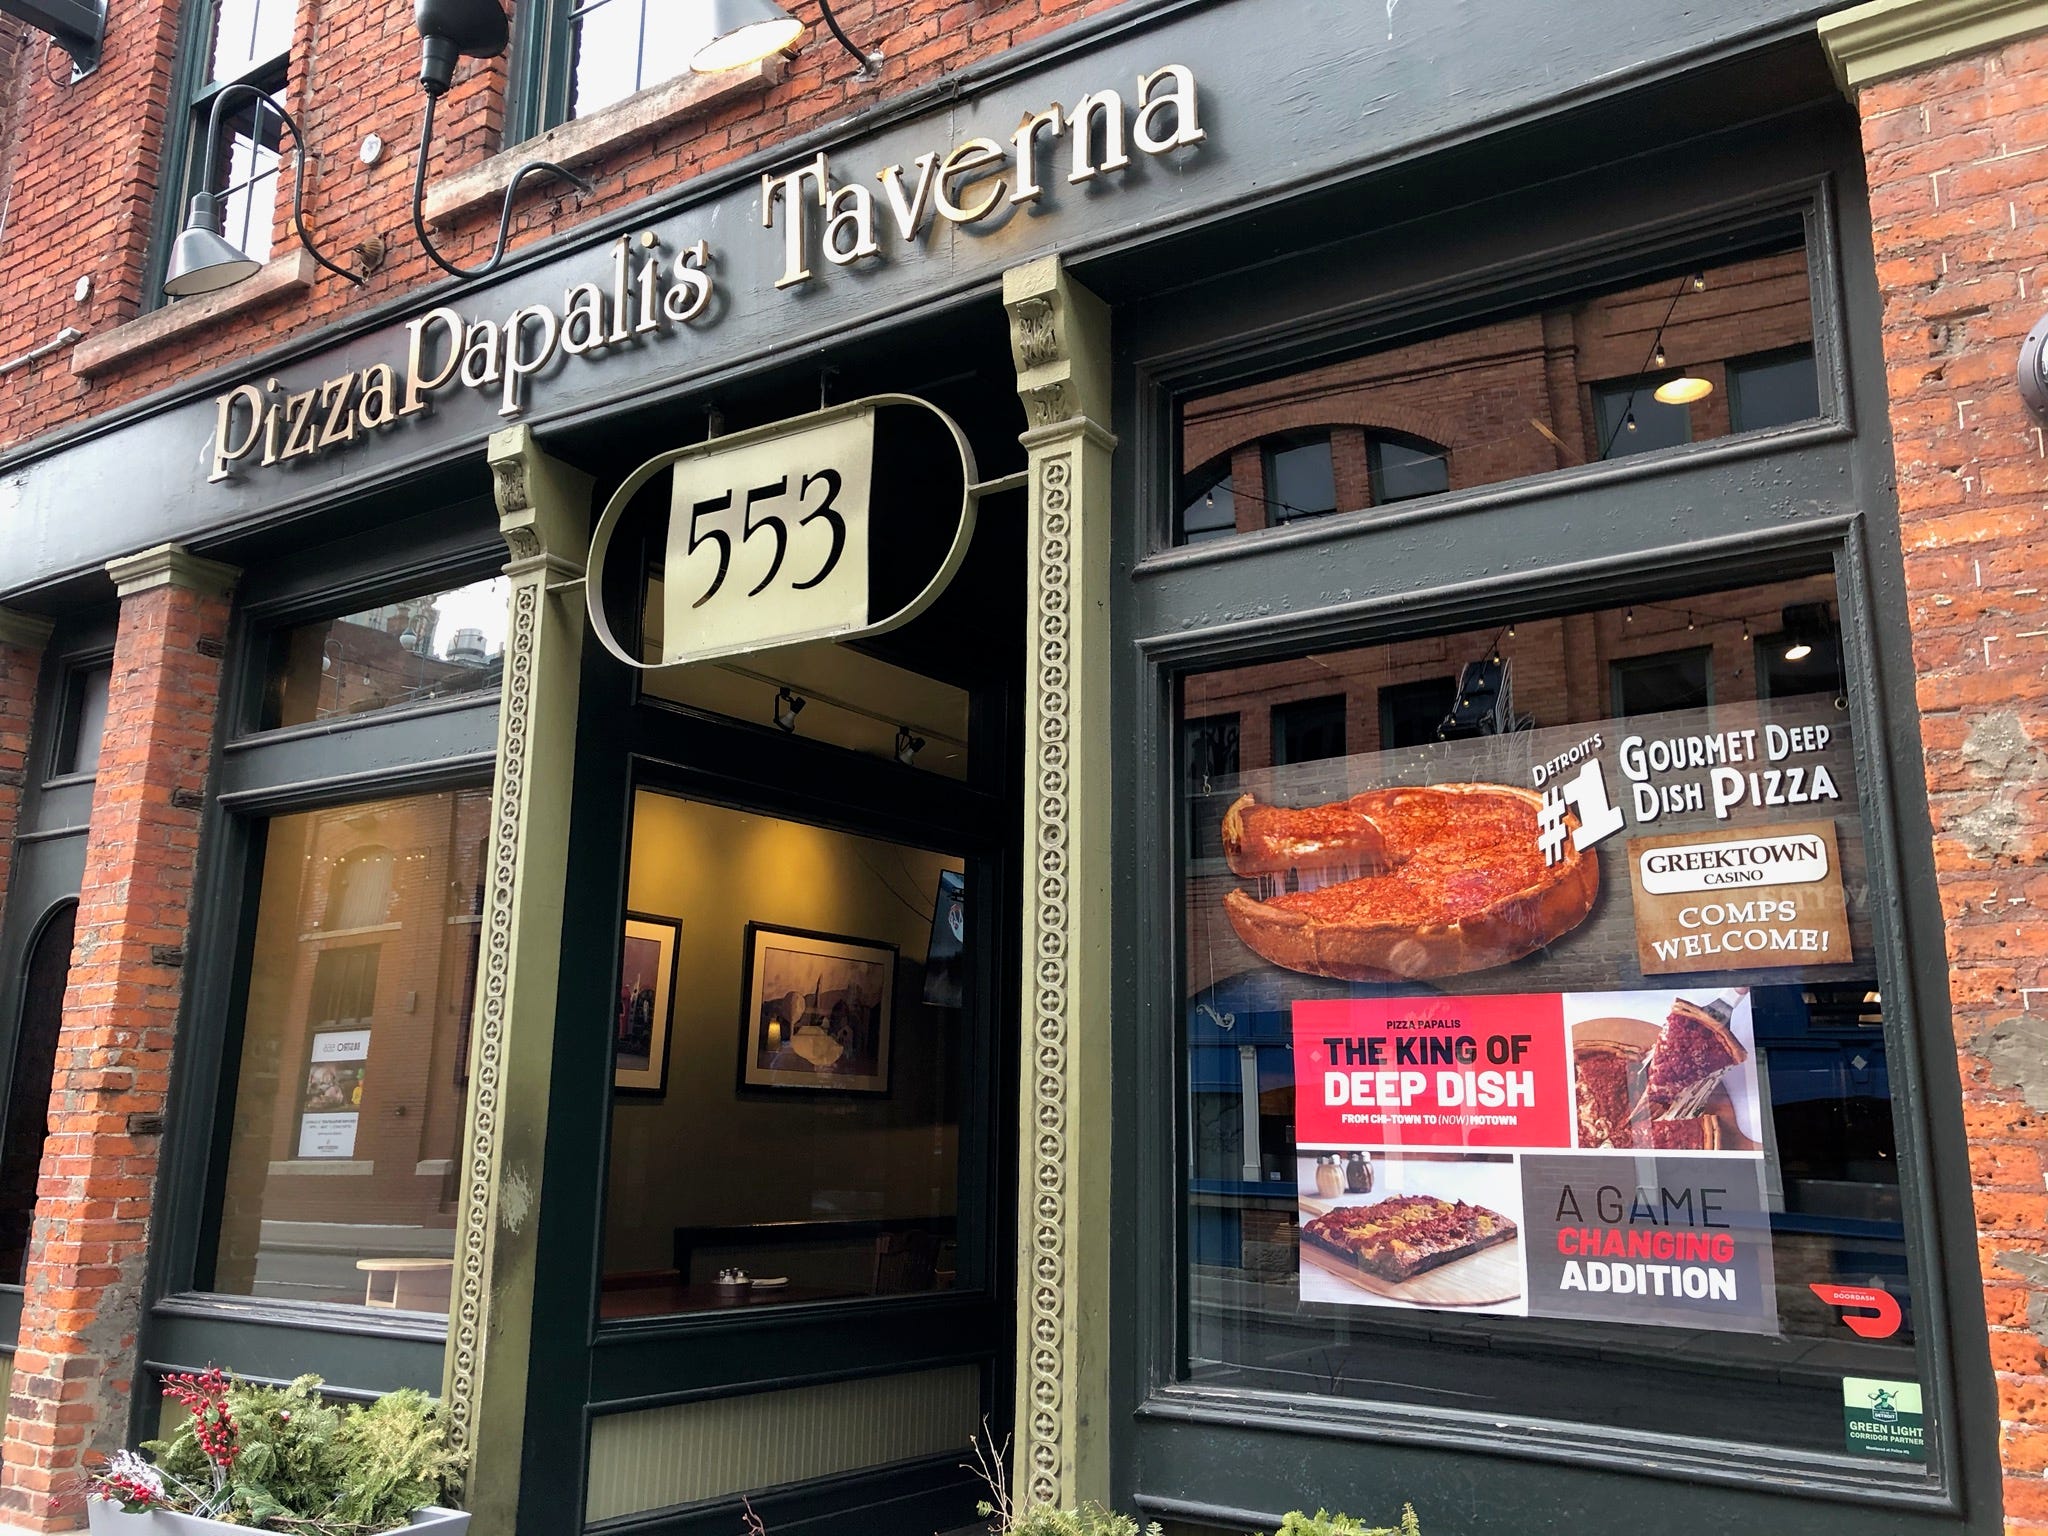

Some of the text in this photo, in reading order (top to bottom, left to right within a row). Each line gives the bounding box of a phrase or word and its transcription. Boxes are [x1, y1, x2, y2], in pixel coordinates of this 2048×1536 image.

[761, 63, 1207, 290] Taverna
[687, 467, 847, 609] 553
[1532, 733, 1603, 788] DETROIT'S
[1619, 725, 1830, 781] GOURMET DEEP
[1632, 765, 1838, 822] DISH PIZZA
[1537, 758, 1625, 867] #1
[1646, 842, 1818, 874] GREEKTOWN
[1704, 870, 1764, 885] CASINO
[1678, 901, 1797, 929] COMPS
[1652, 929, 1830, 962] WELCOME!
[1386, 1020, 1461, 1030] PIZZA PAPALIS
[1323, 1034, 1532, 1066] THE KING OF
[1324, 1070, 1535, 1108] DEEP DISH
[1341, 1113, 1517, 1125] FROM CHI-TOWN TO (NOW) MOTOWN
[1556, 1185, 1729, 1229] A GAME
[1557, 1227, 1735, 1263] CHANGING
[1559, 1260, 1737, 1301] ADDITION
[1834, 1293, 1875, 1301] DOORDASH
[1850, 1421, 1923, 1437] GREEN LIGHT
[1850, 1432, 1924, 1445] CORRIDOR PARTNER
